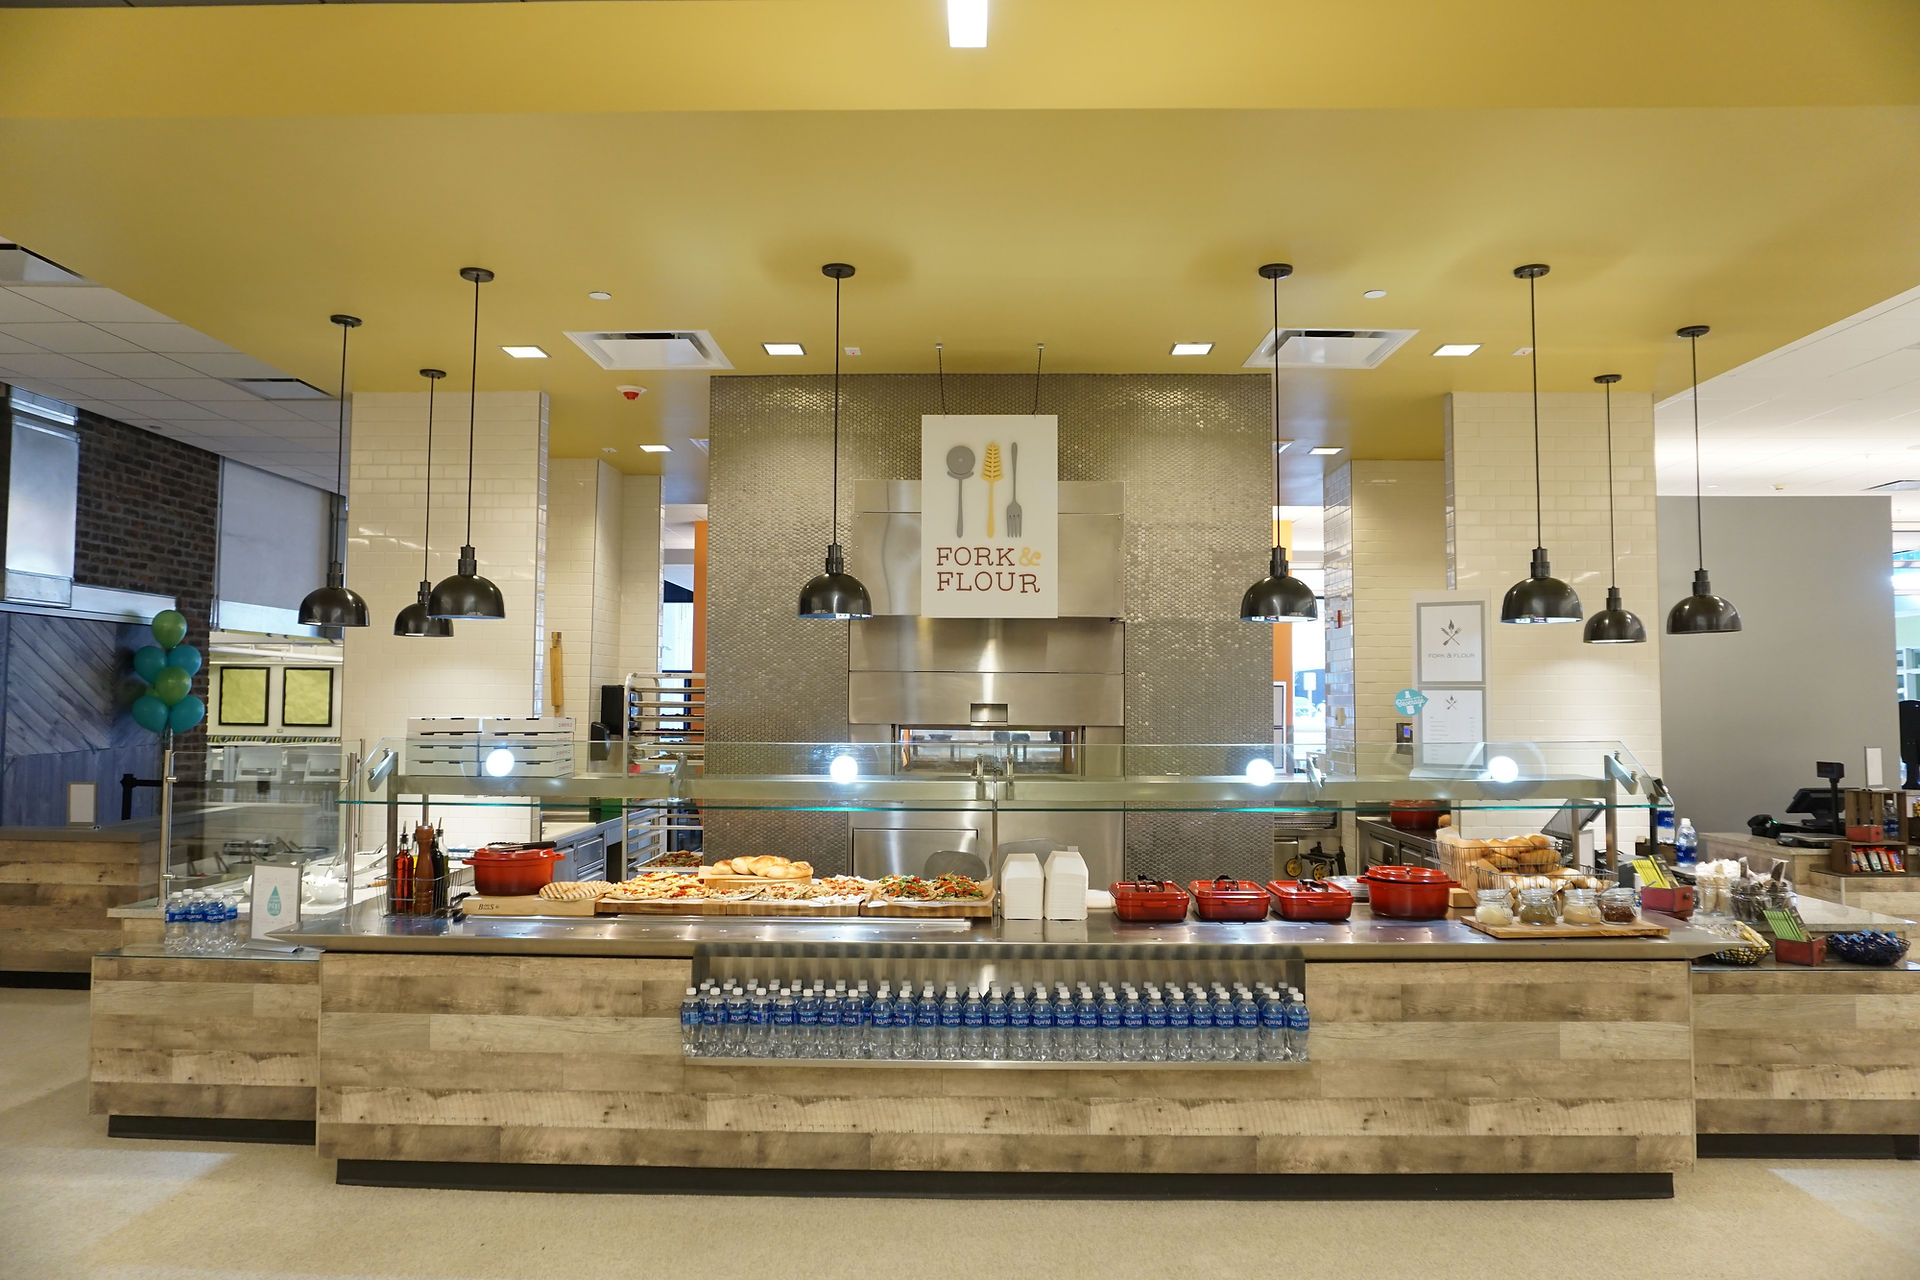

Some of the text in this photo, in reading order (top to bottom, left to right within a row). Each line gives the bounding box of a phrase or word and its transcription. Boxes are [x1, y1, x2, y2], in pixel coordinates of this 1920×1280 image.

[936, 547, 1042, 567] FORK &
[936, 571, 1041, 594] FLOUR
